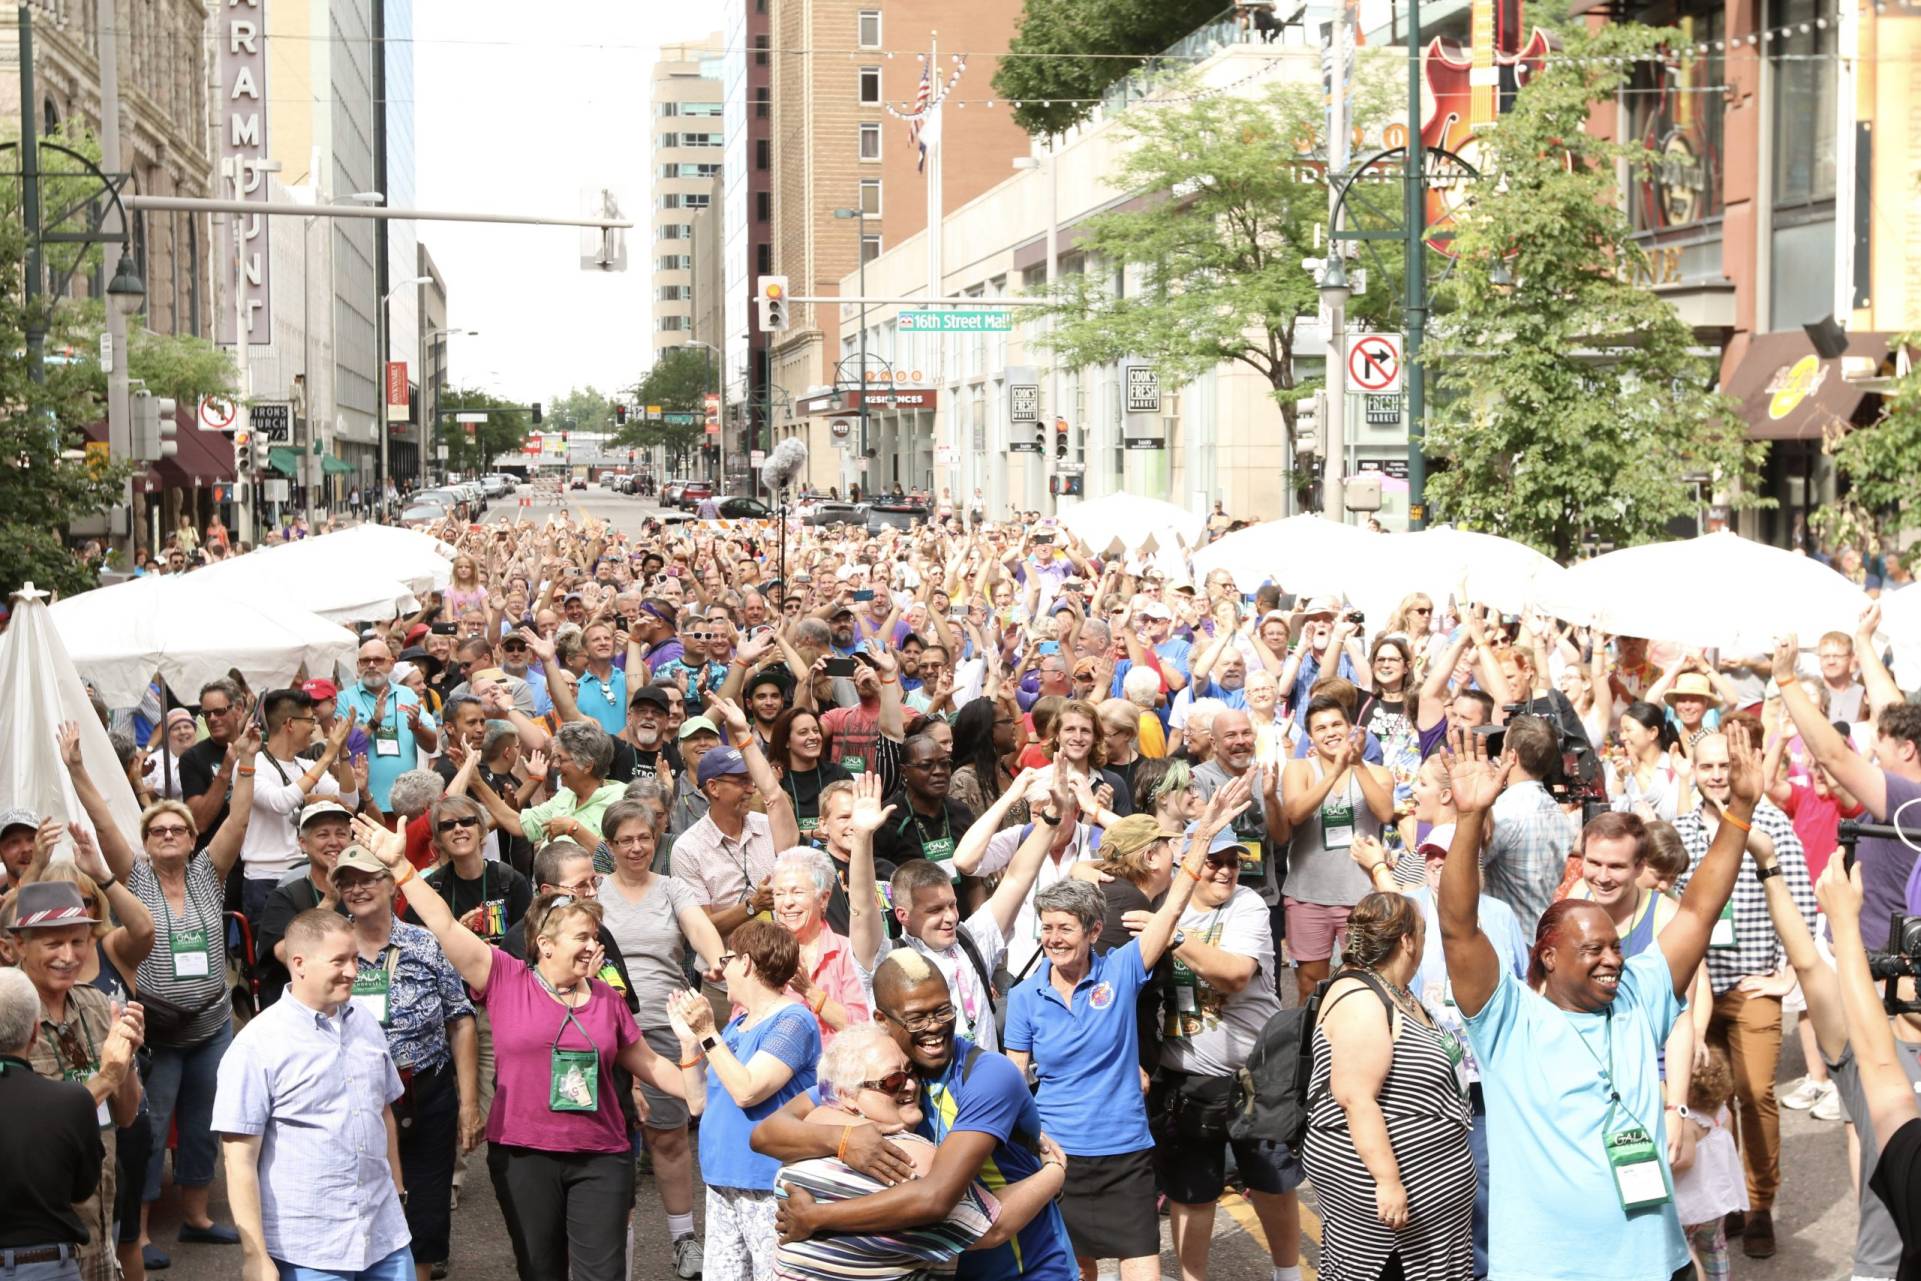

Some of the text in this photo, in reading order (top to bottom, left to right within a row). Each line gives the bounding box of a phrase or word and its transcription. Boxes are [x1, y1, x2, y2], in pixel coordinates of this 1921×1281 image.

[914, 314, 1010, 329] 16th Street Mall
[1130, 371, 1158, 382] COOK'S
[1014, 388, 1036, 398] COOK'S
[1130, 385, 1158, 398] FRESH
[865, 395, 923, 404] RESINCES
[1130, 400, 1158, 408] MARKET
[1367, 395, 1399, 411] FRESH
[1014, 400, 1036, 411] FRESH
[1367, 413, 1399, 422] MARKET
[250, 418, 287, 428] HURCH
[1326, 808, 1348, 816] GALA
[928, 841, 950, 851] GALA
[176, 932, 202, 942] GALA
[1615, 1130, 1649, 1146] GALA
